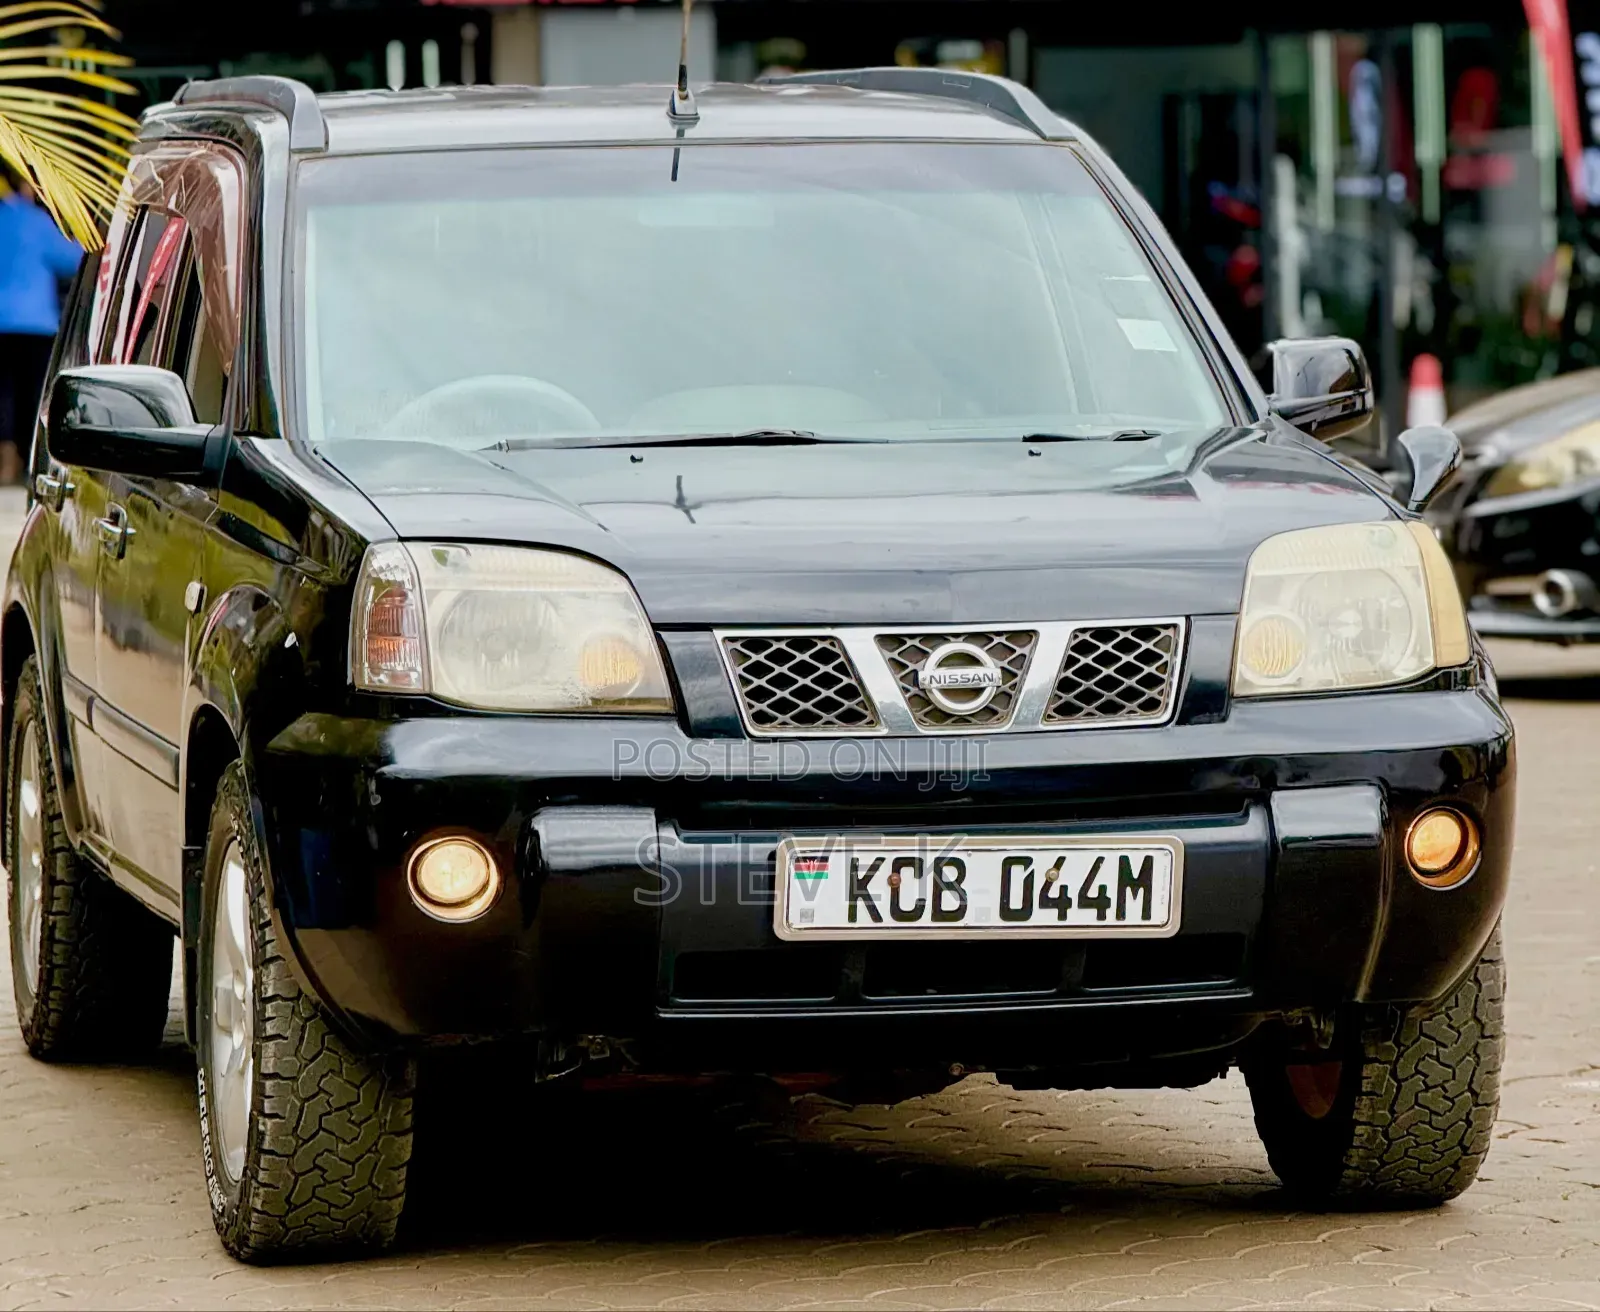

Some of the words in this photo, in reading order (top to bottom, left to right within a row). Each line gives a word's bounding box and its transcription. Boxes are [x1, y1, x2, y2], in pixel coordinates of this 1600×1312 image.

[929, 672, 994, 685] NISSAN
[847, 856, 969, 923] KCB
[999, 855, 1155, 922] 044M
